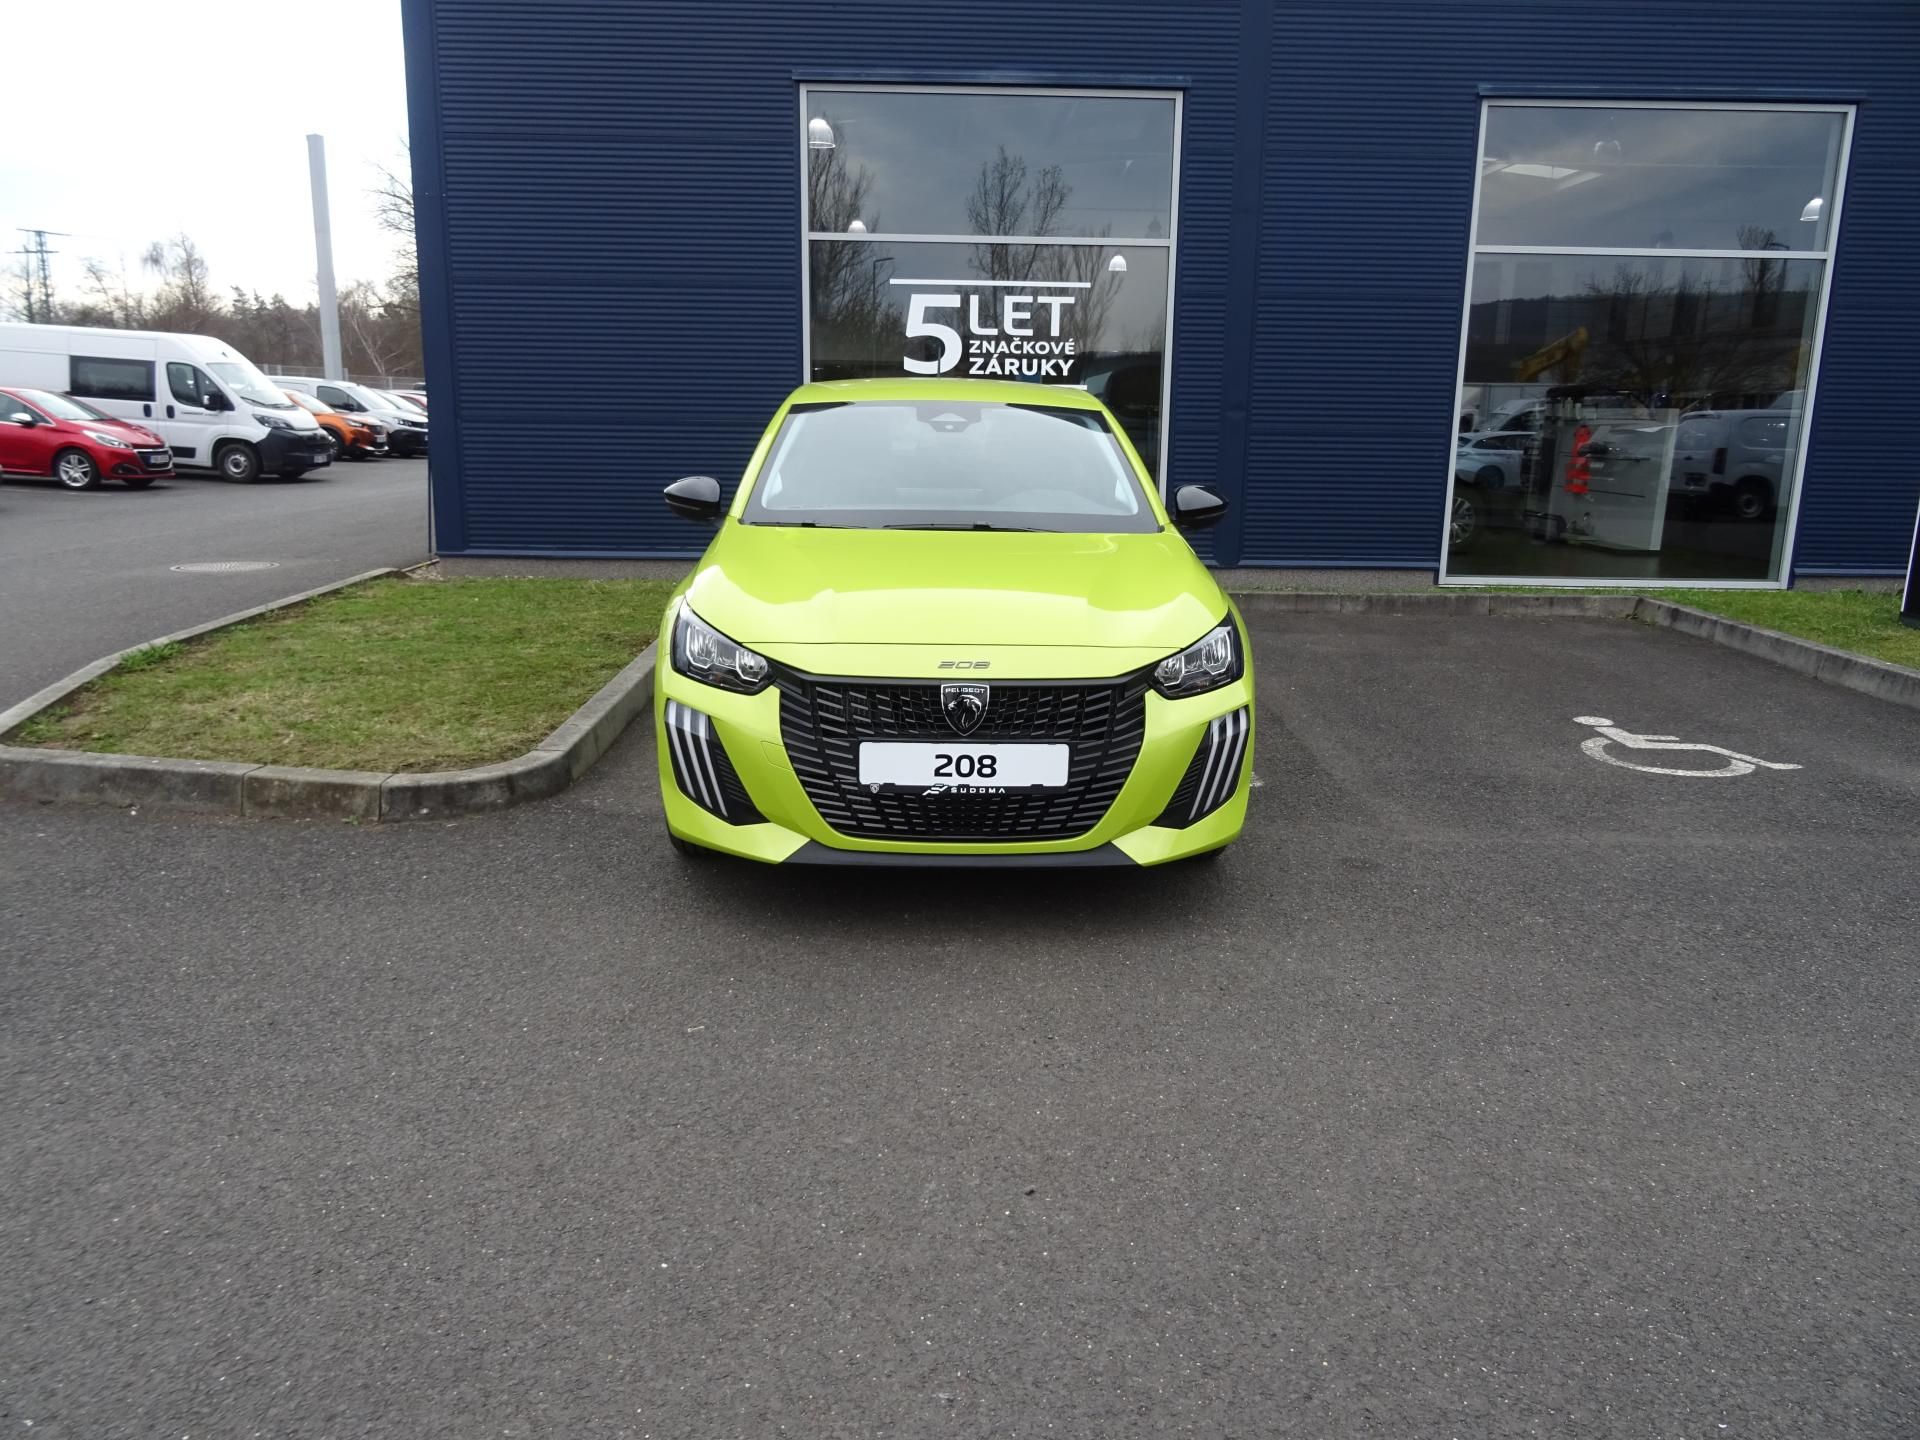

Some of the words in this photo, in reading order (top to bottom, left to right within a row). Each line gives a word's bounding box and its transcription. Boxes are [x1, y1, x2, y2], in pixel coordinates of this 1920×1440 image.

[904, 294, 963, 375] 5
[969, 295, 1076, 337] LET
[969, 338, 1076, 355] ZNAČKOVÉ
[969, 354, 1075, 376] ZÁRUKY
[938, 661, 991, 669] 208
[933, 753, 997, 778] 208
